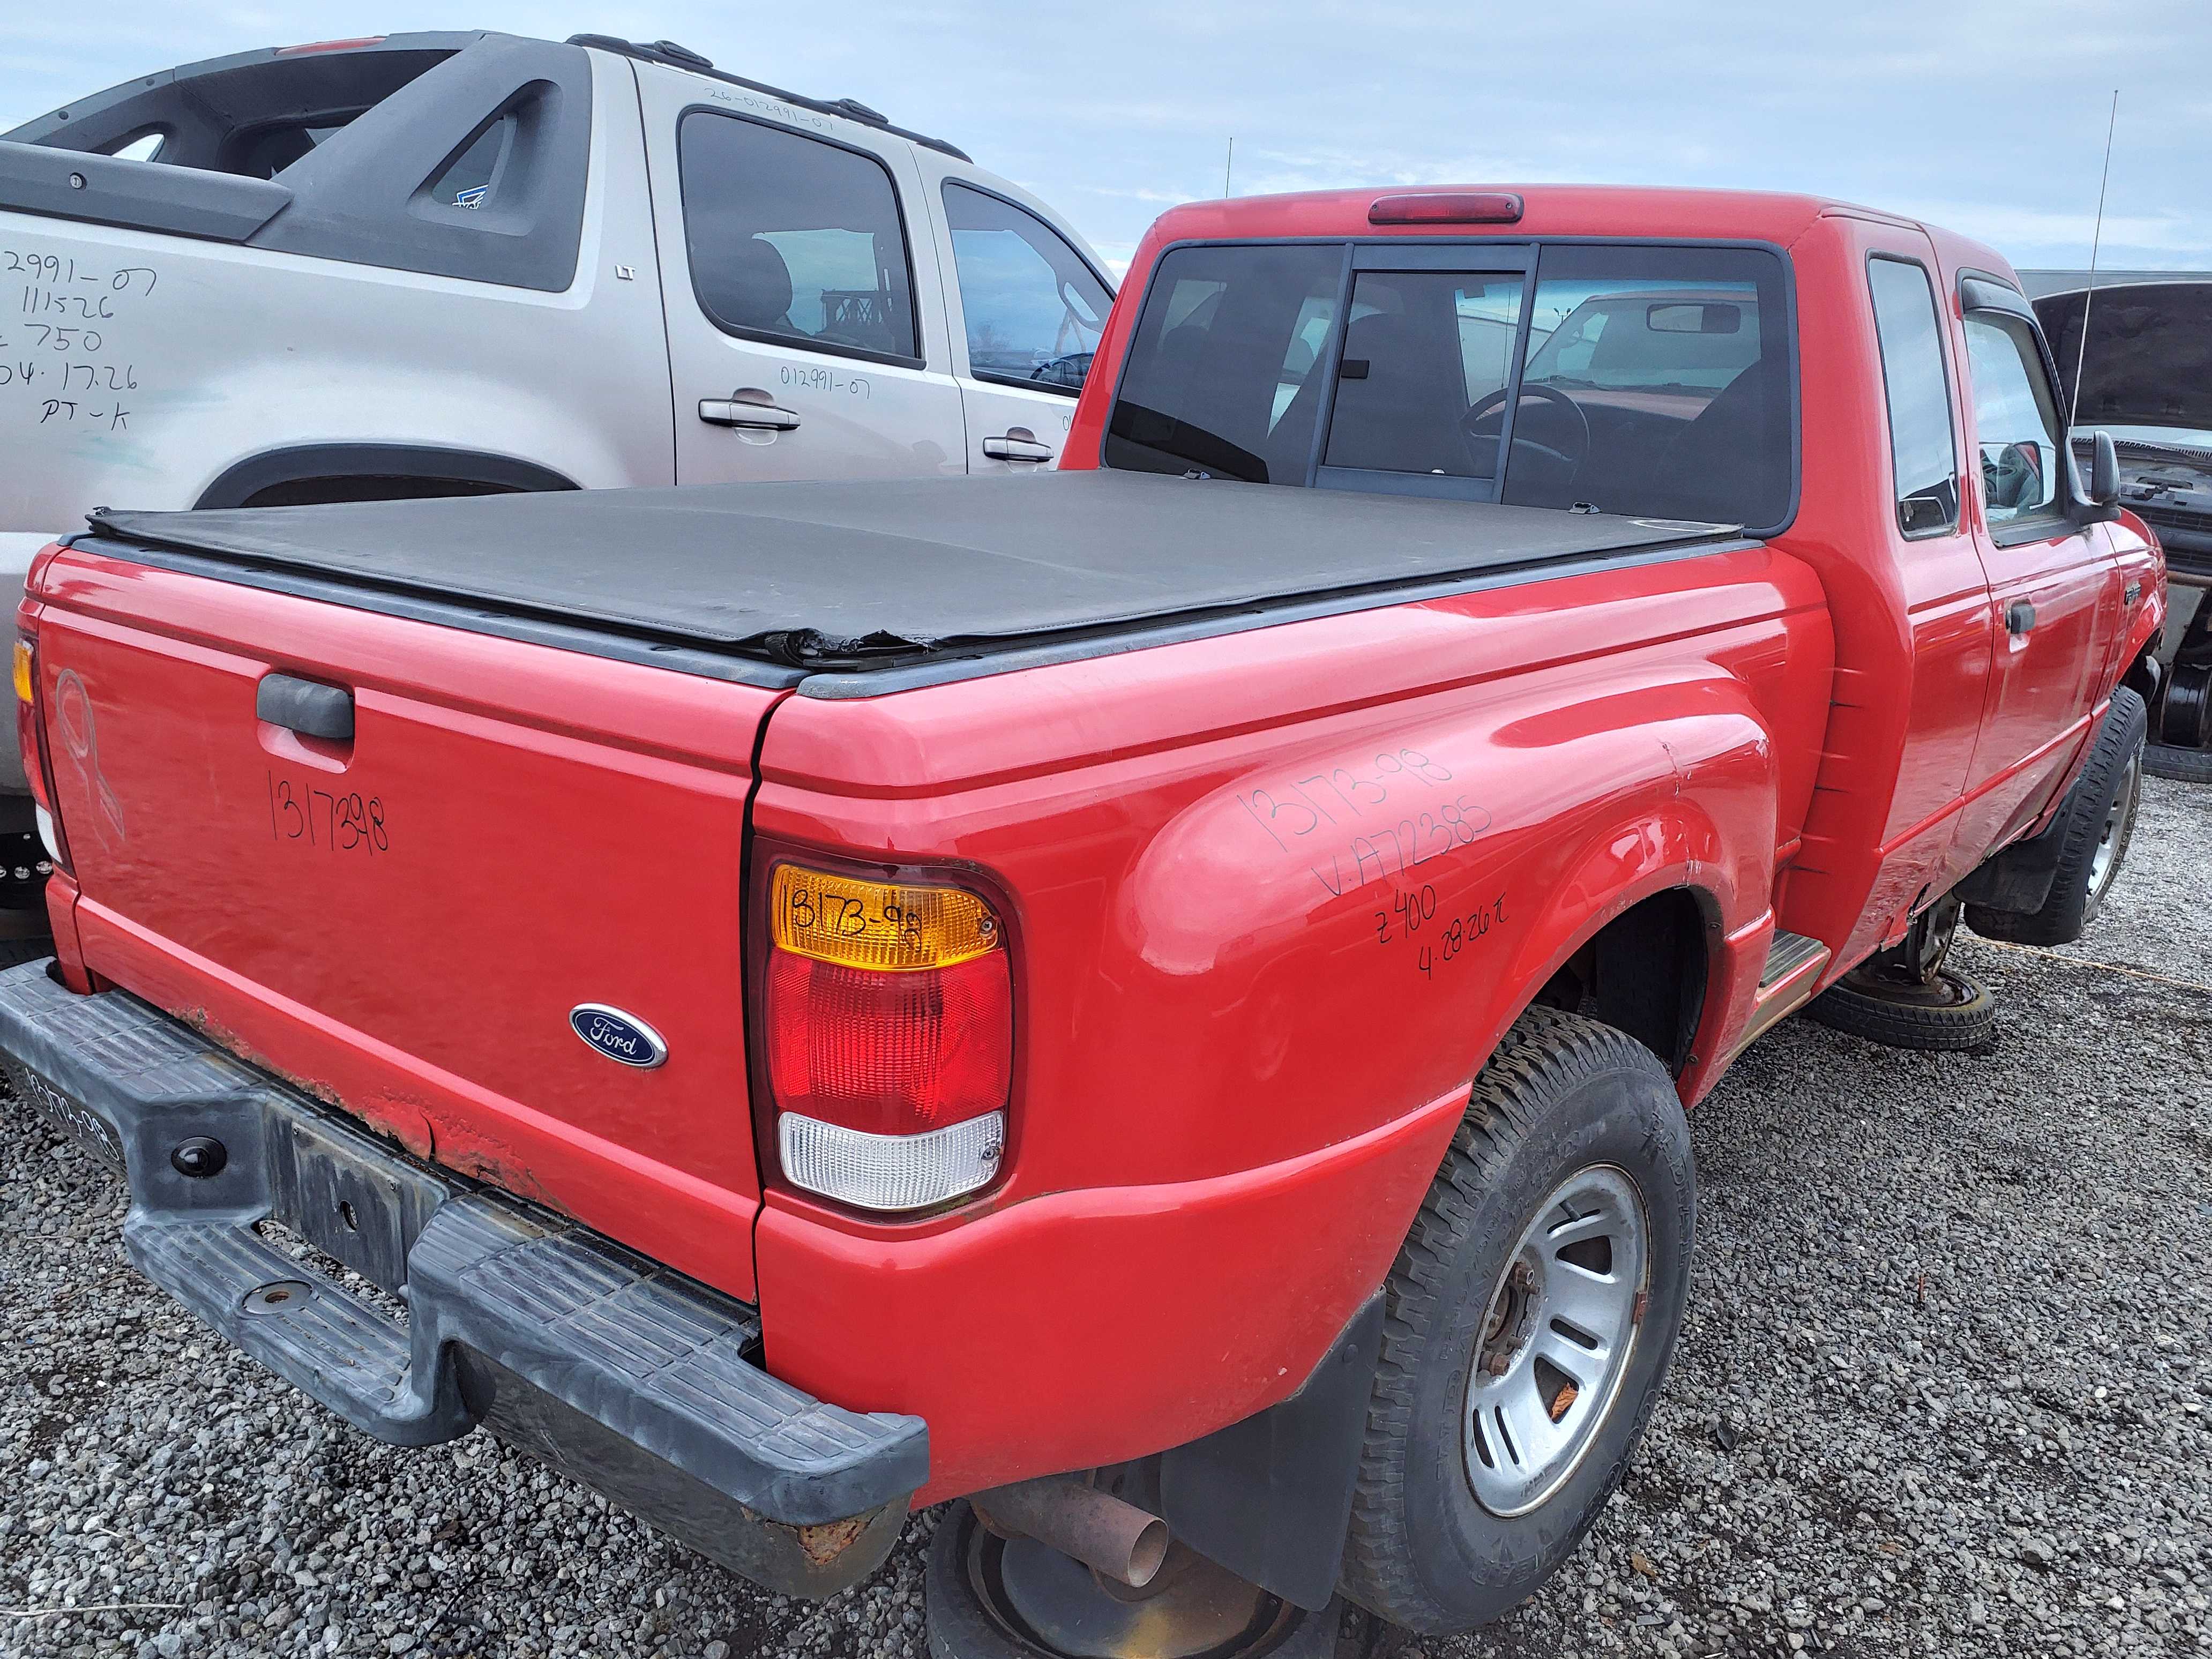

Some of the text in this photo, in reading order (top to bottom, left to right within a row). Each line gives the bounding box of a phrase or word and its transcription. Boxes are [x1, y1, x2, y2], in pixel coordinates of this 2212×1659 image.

[615, 265, 636, 281] LT
[24, 323, 102, 352] 750
[781, 366, 870, 399] 012991-07
[1394, 885, 1436, 939] 400
[590, 1017, 637, 1055] Ford
